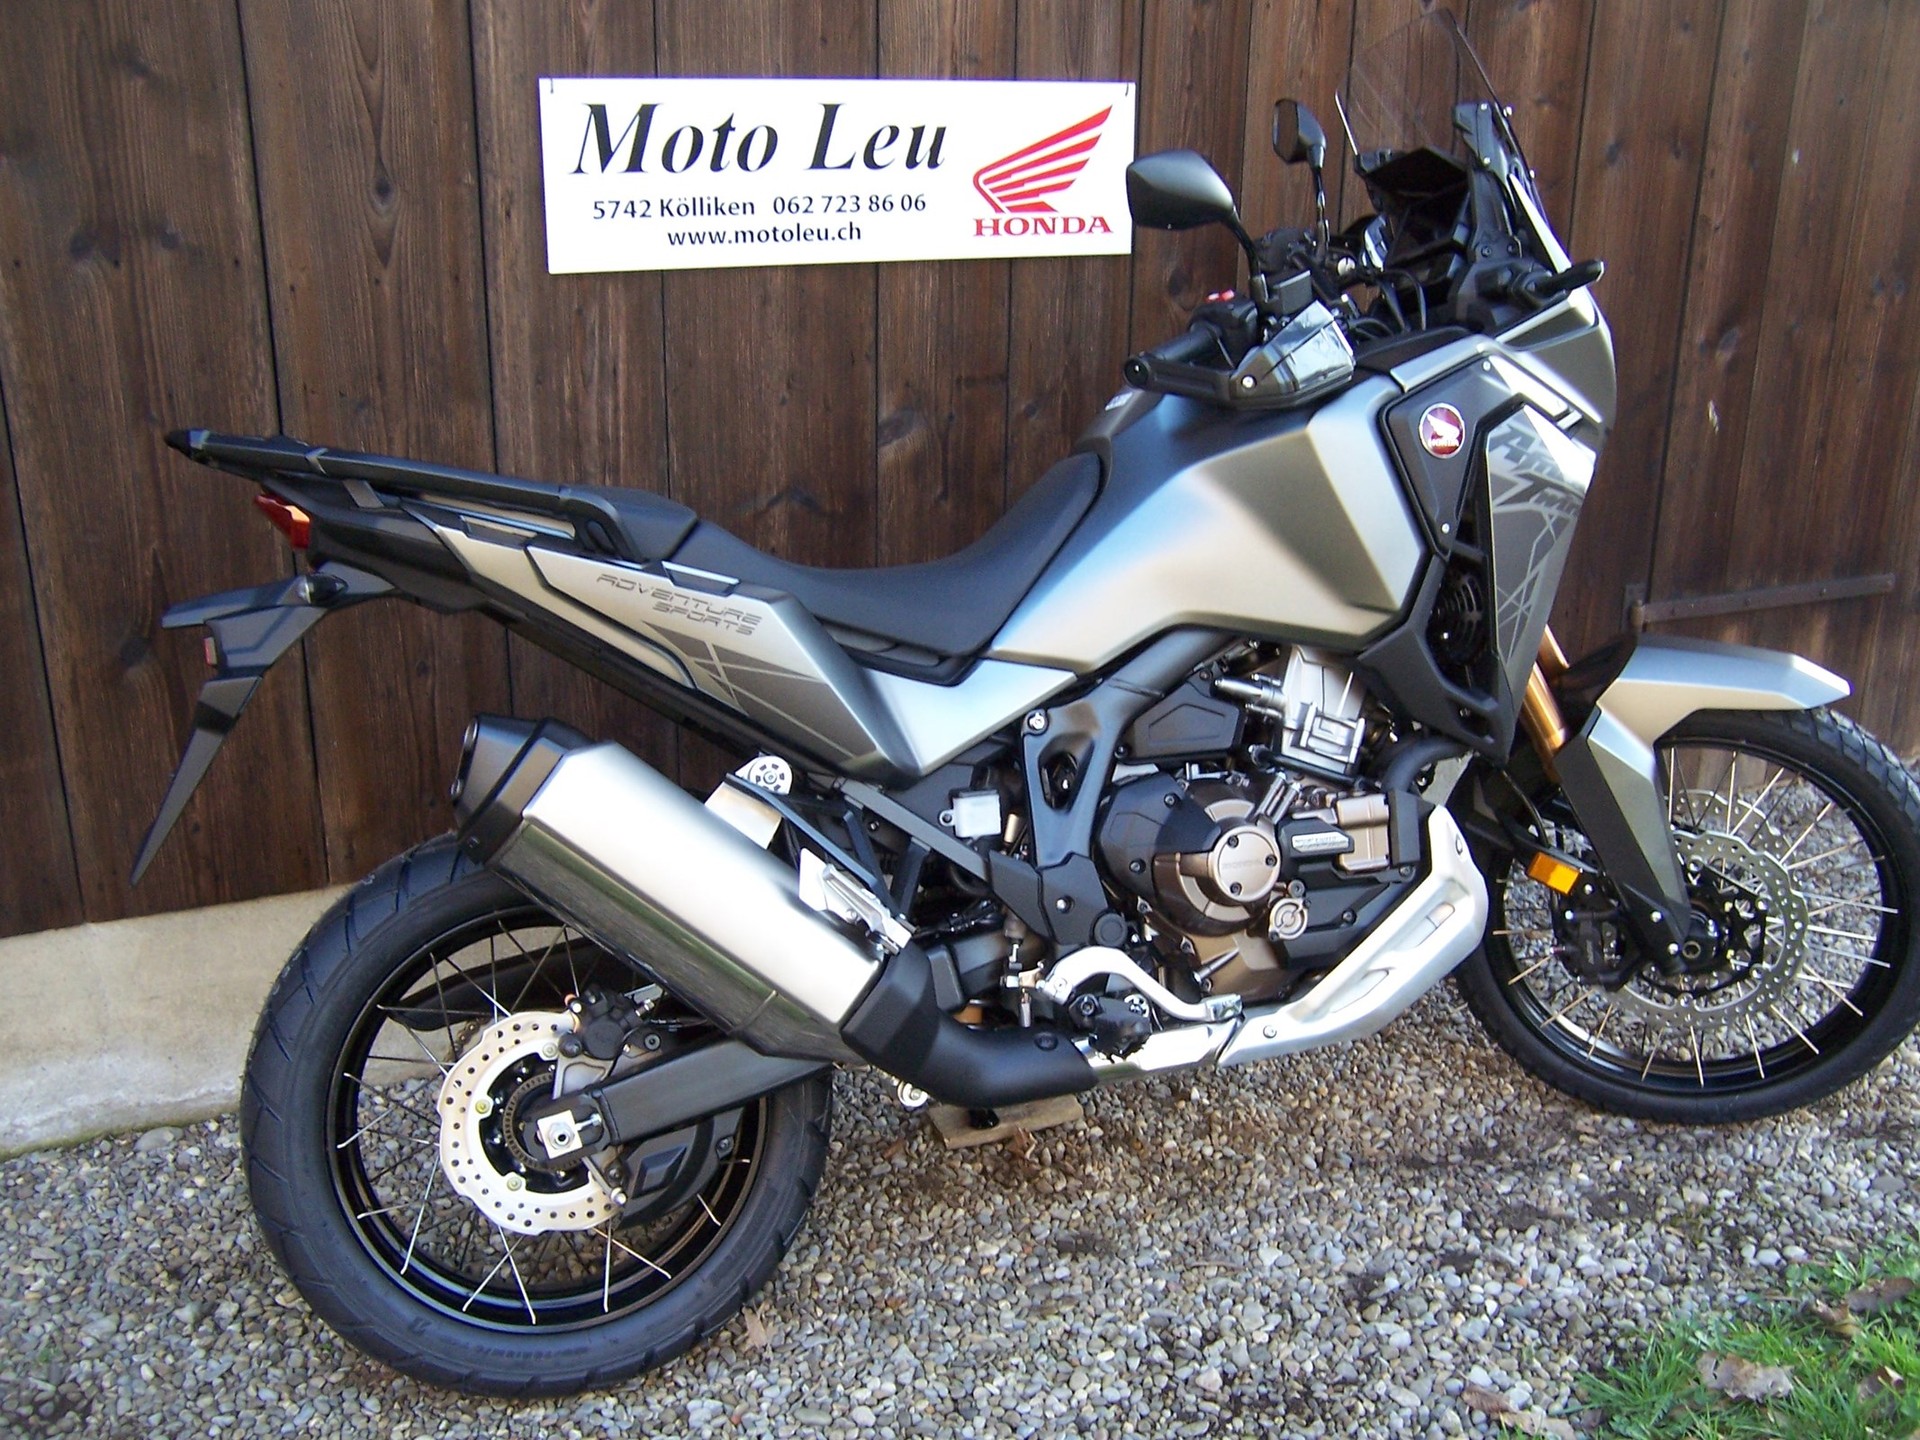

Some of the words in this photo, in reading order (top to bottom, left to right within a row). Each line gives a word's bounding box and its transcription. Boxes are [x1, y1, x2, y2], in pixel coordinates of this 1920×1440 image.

[572, 103, 779, 174] Moto
[803, 103, 948, 170] Leu
[593, 200, 652, 220] 5742
[660, 196, 755, 217] Kölliken
[772, 197, 814, 215] 062
[822, 195, 863, 213] 723
[868, 194, 894, 212] 86
[900, 194, 926, 212] 06
[667, 222, 861, 246] www.motoleu.ch
[973, 216, 1113, 236] HONDA
[597, 573, 762, 626] ADVENTURE
[652, 603, 756, 635] SPORTS
